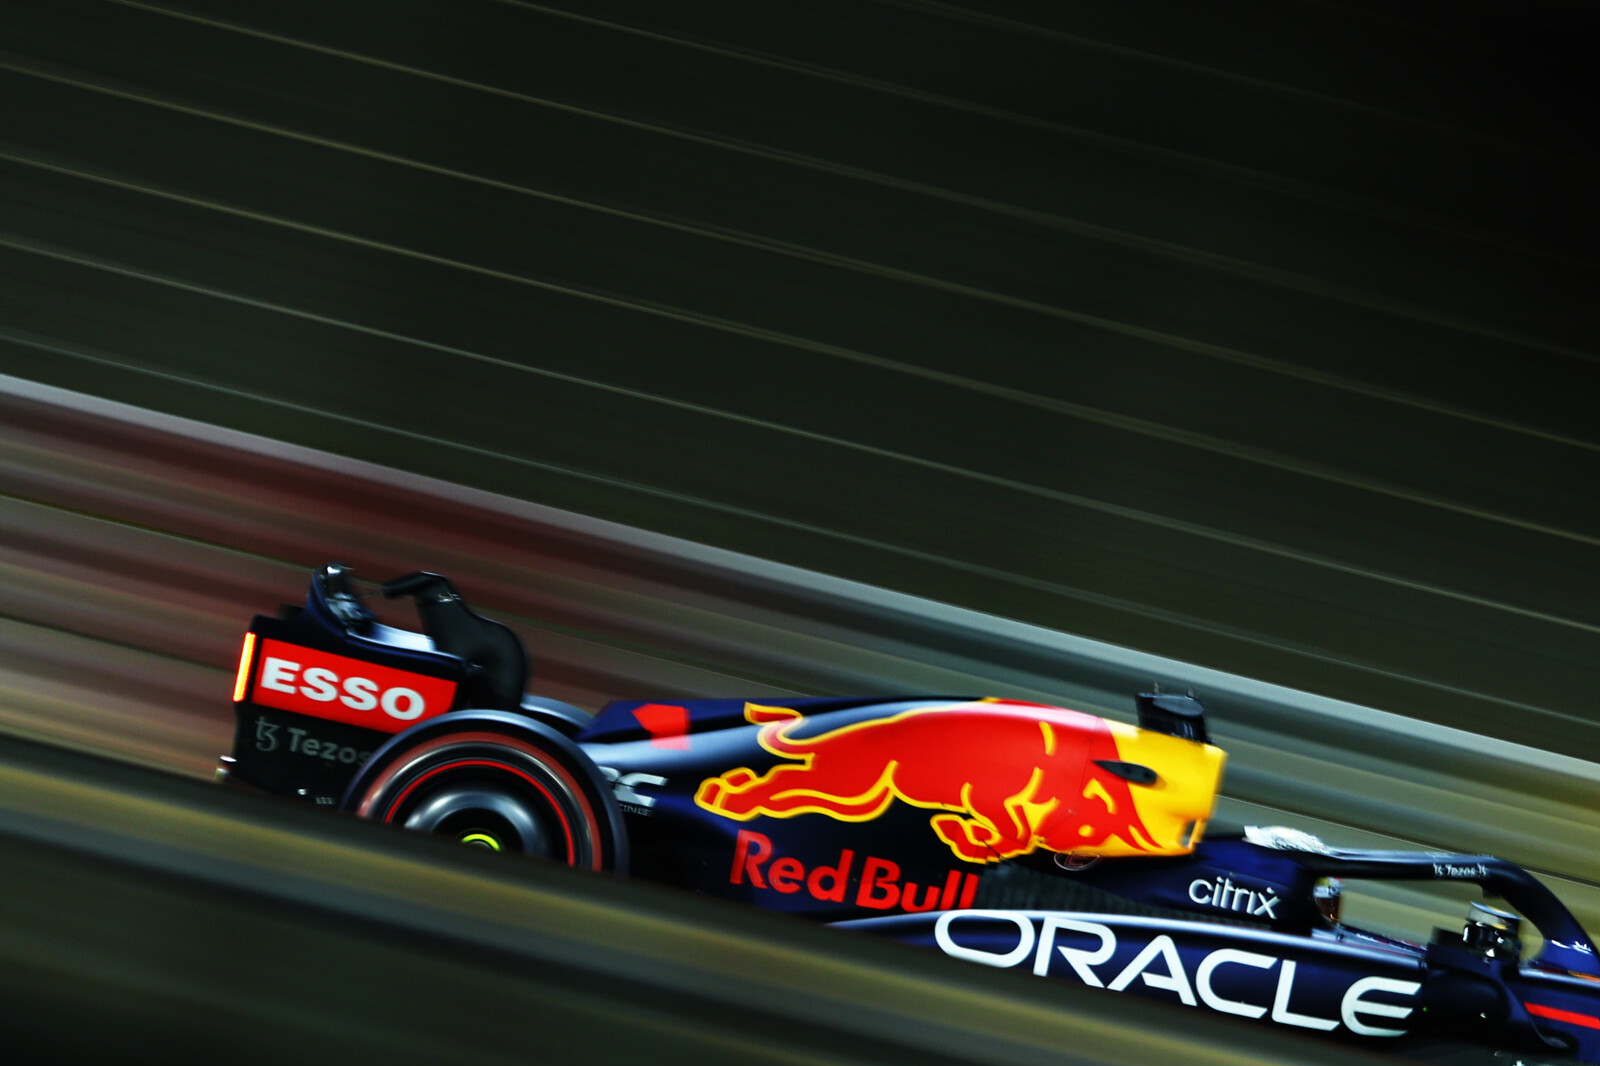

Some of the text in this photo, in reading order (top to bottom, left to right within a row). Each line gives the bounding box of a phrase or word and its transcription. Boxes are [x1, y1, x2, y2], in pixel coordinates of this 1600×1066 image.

[260, 656, 427, 721] ESSO
[729, 829, 980, 913] Red Bull
[1188, 876, 1281, 920] citrix
[934, 910, 1422, 1038] ORACLE
